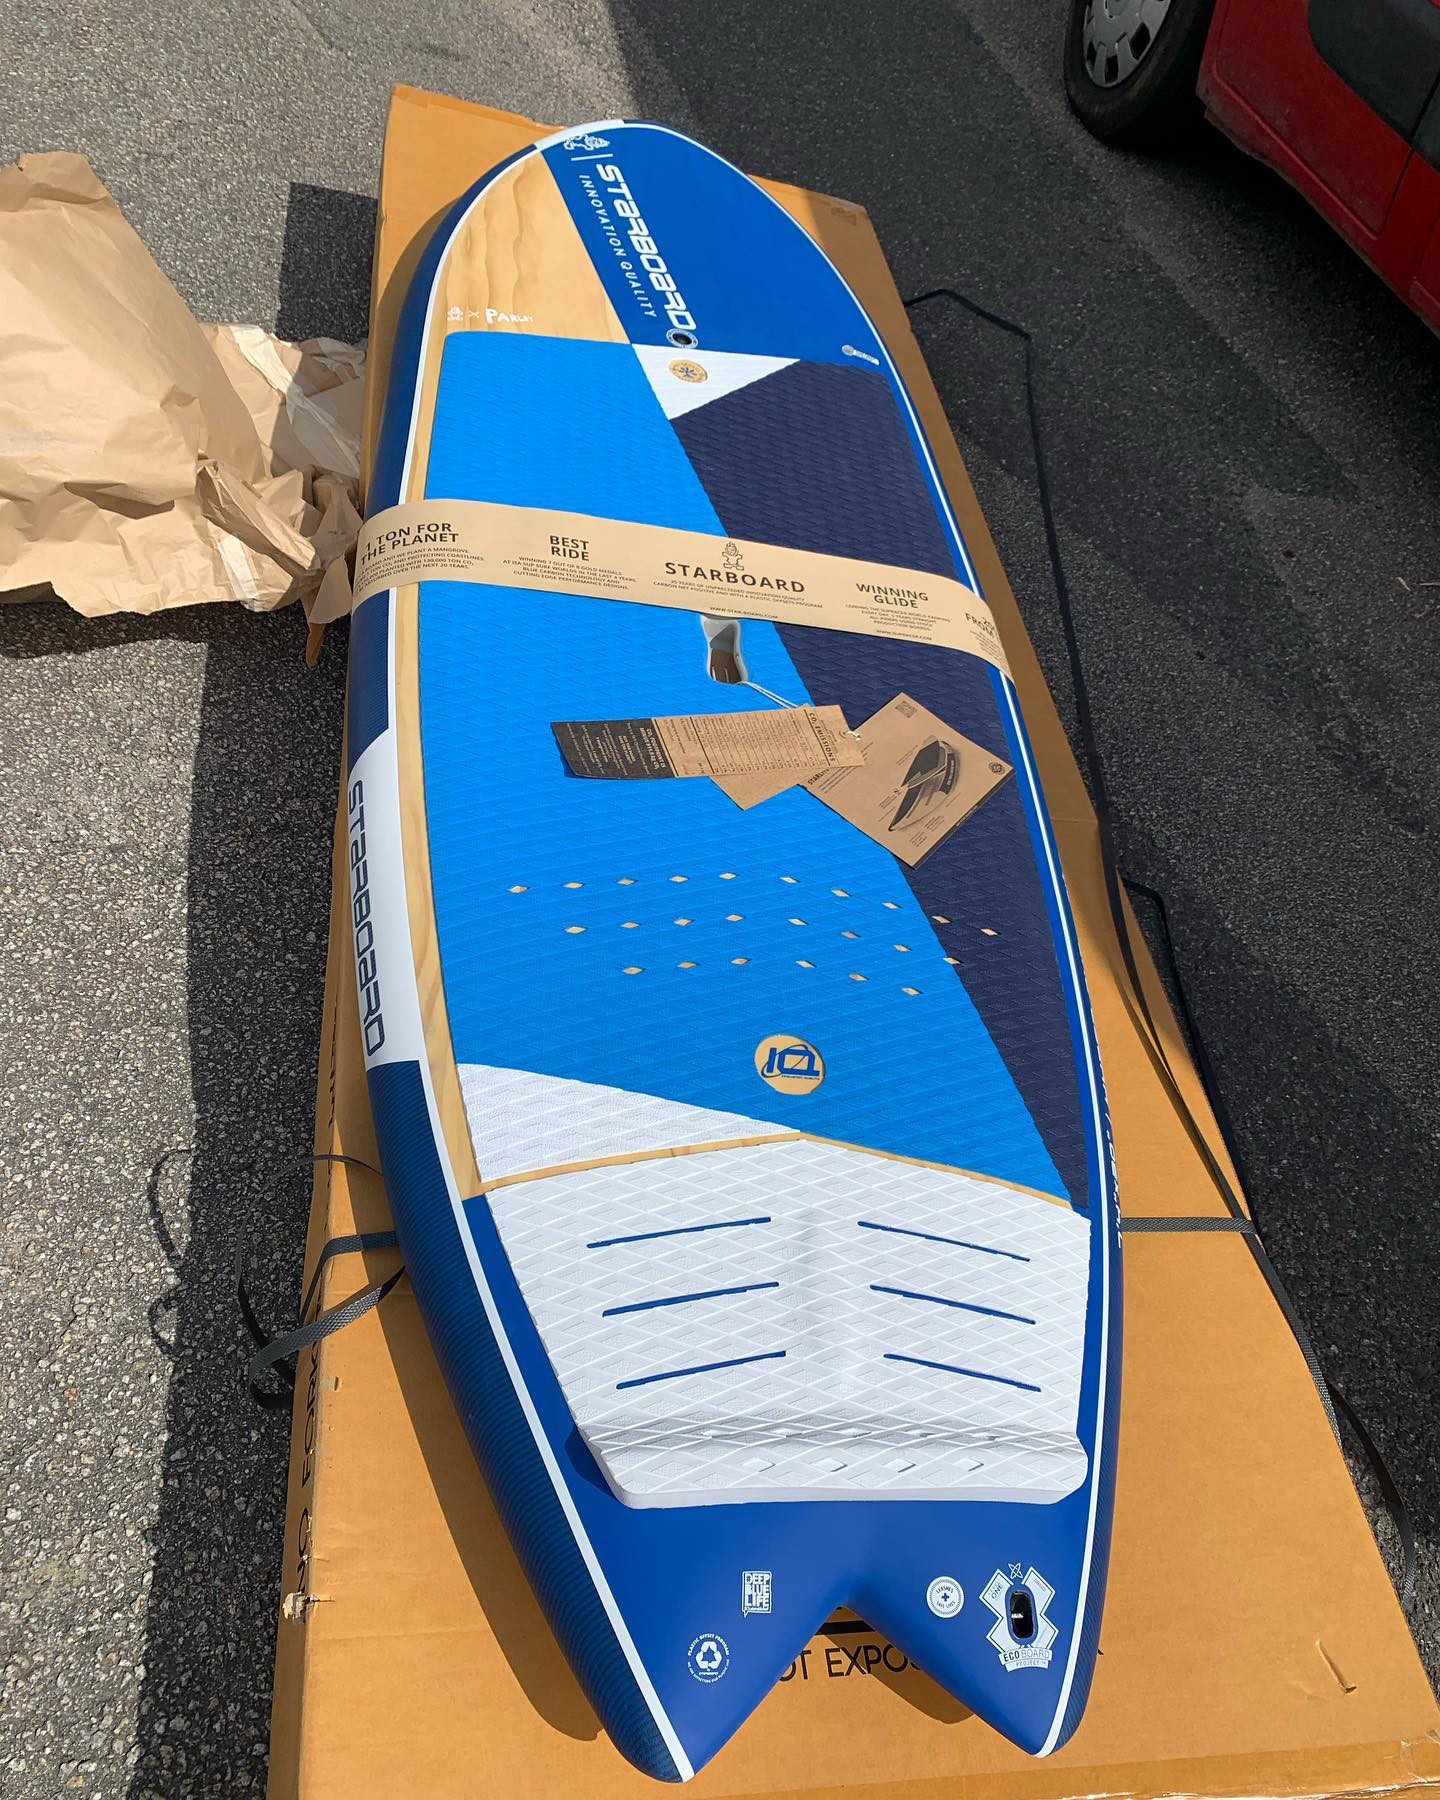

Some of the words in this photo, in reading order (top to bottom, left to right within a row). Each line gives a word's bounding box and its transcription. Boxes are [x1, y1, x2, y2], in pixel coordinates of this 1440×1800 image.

[579, 174, 627, 257] INNOVATION
[620, 261, 657, 318] QUALITY
[376, 526, 410, 546] TON
[417, 523, 452, 534] FOR
[549, 535, 590, 551] BEST
[361, 544, 386, 566] THE
[392, 533, 459, 550] PLANET
[551, 546, 590, 562] RIDE
[664, 562, 806, 594] STARBOARD
[855, 583, 929, 602] WINNING
[873, 594, 919, 609] GLIDE
[814, 725, 836, 762] EMISSIONS
[744, 1573, 770, 1585] DEEP
[744, 1584, 770, 1596] BLUE
[990, 1583, 1004, 1600] ONE
[744, 1595, 770, 1607] LIFE
[824, 1643, 921, 1678] EXPO
